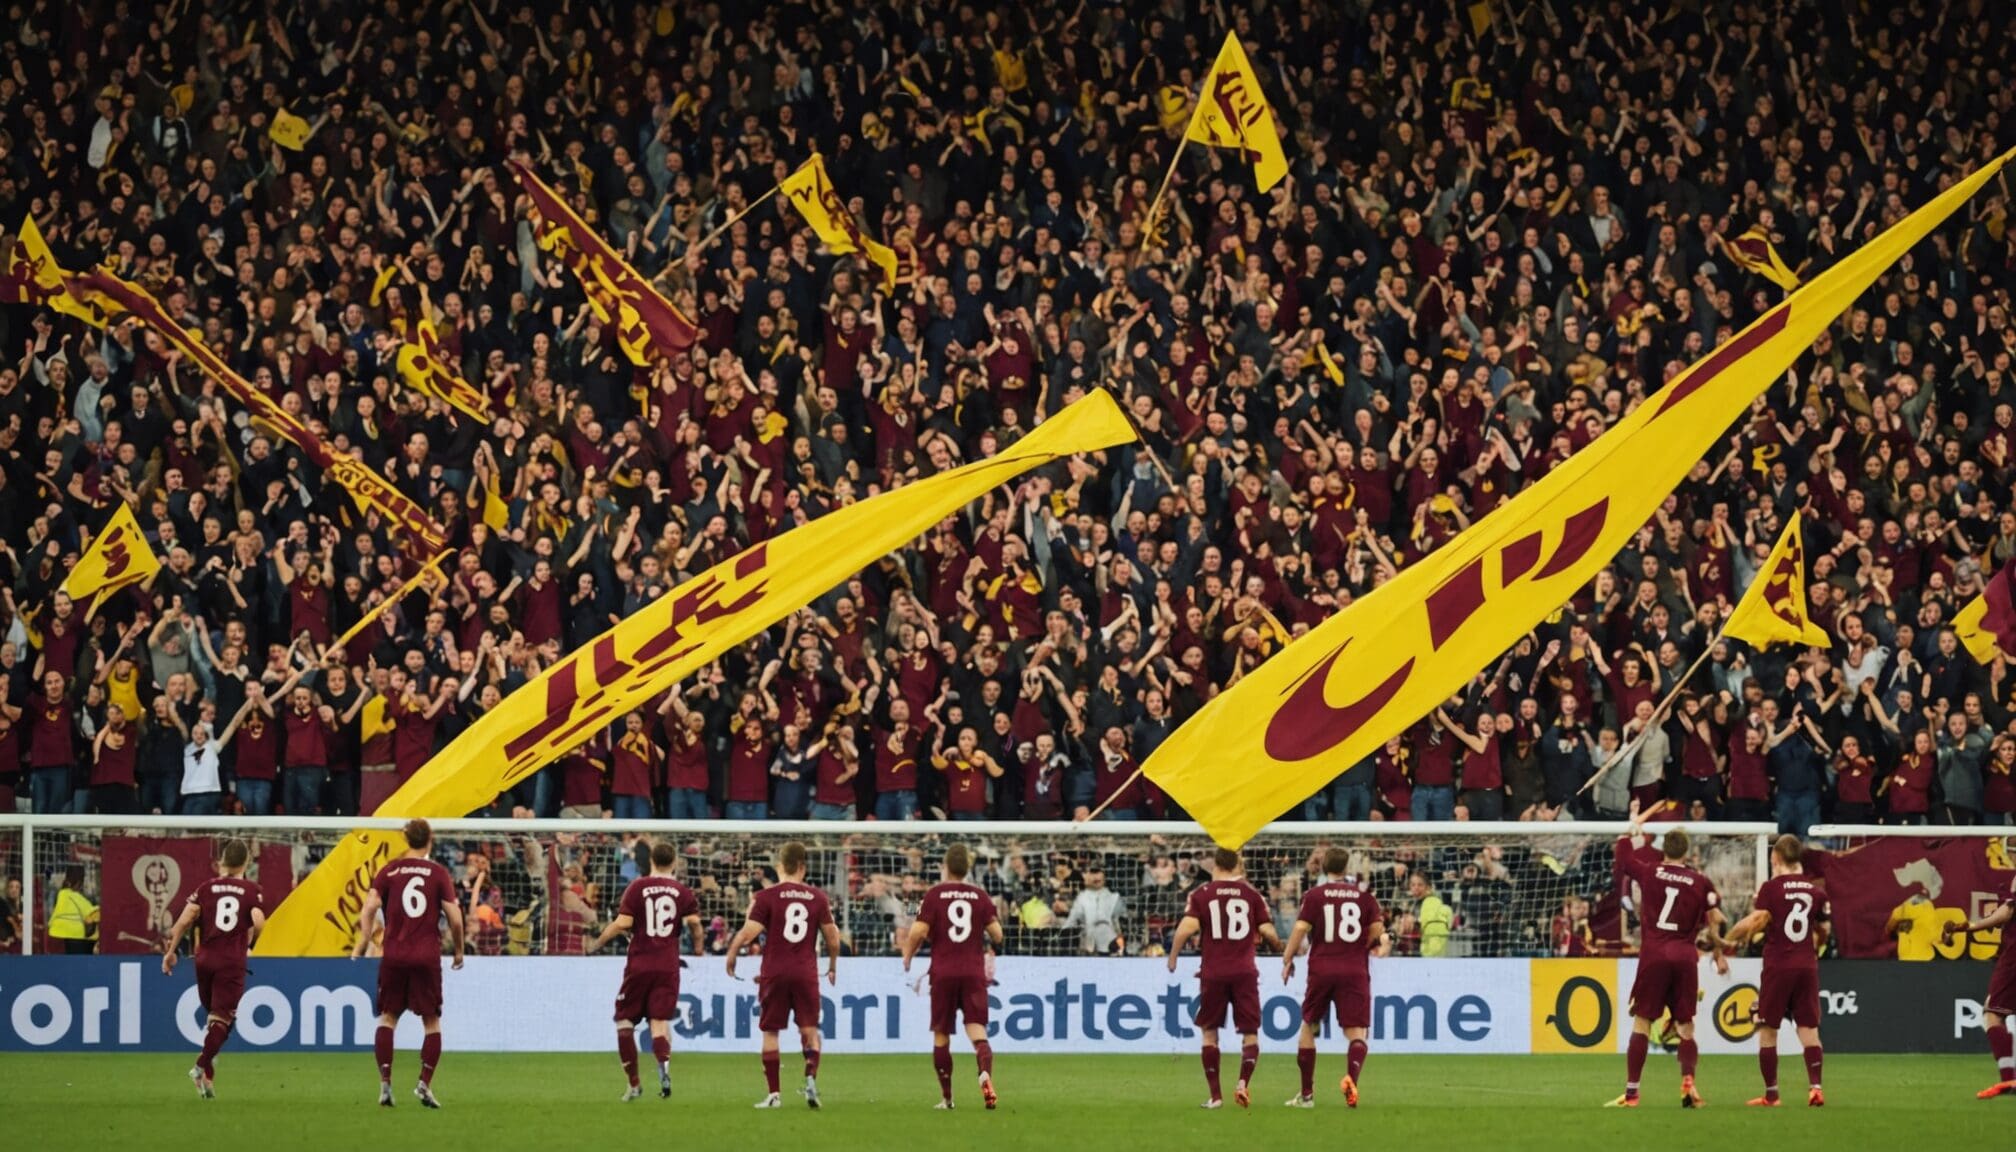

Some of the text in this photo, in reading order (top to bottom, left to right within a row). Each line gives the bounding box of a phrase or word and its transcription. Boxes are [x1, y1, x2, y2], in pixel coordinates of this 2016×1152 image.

[402, 876, 432, 918] 6
[783, 902, 809, 944] 8
[947, 900, 973, 943] 9
[1323, 901, 1362, 943] 18
